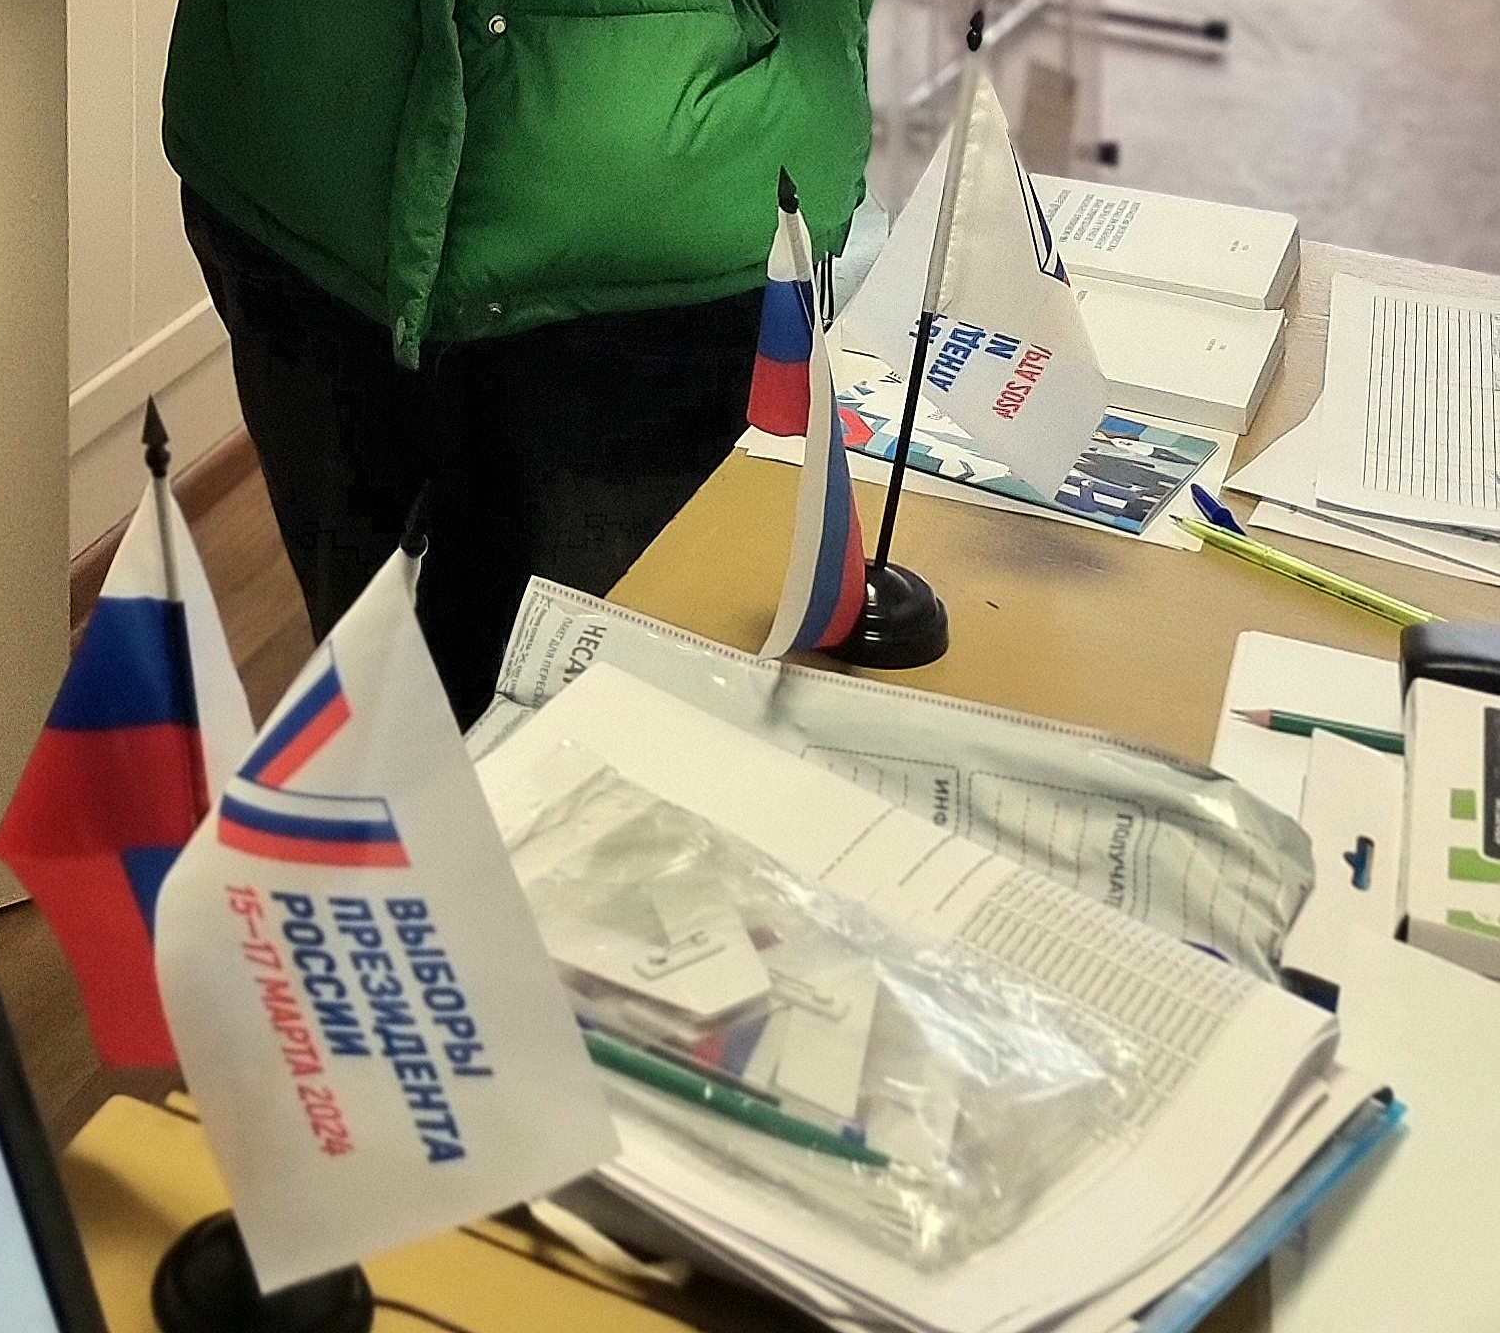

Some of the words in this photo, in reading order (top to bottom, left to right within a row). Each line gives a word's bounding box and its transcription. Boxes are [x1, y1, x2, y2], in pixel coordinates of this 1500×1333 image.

[563, 623, 607, 684] НЕСА
[270, 891, 372, 1058] РОССИИ
[328, 896, 466, 1164] ПРЕЗИДЕНТА
[385, 898, 494, 1077] ВЫБОРЫ
[254, 976, 324, 1077] МАРТА
[298, 1084, 355, 1157] 2024
